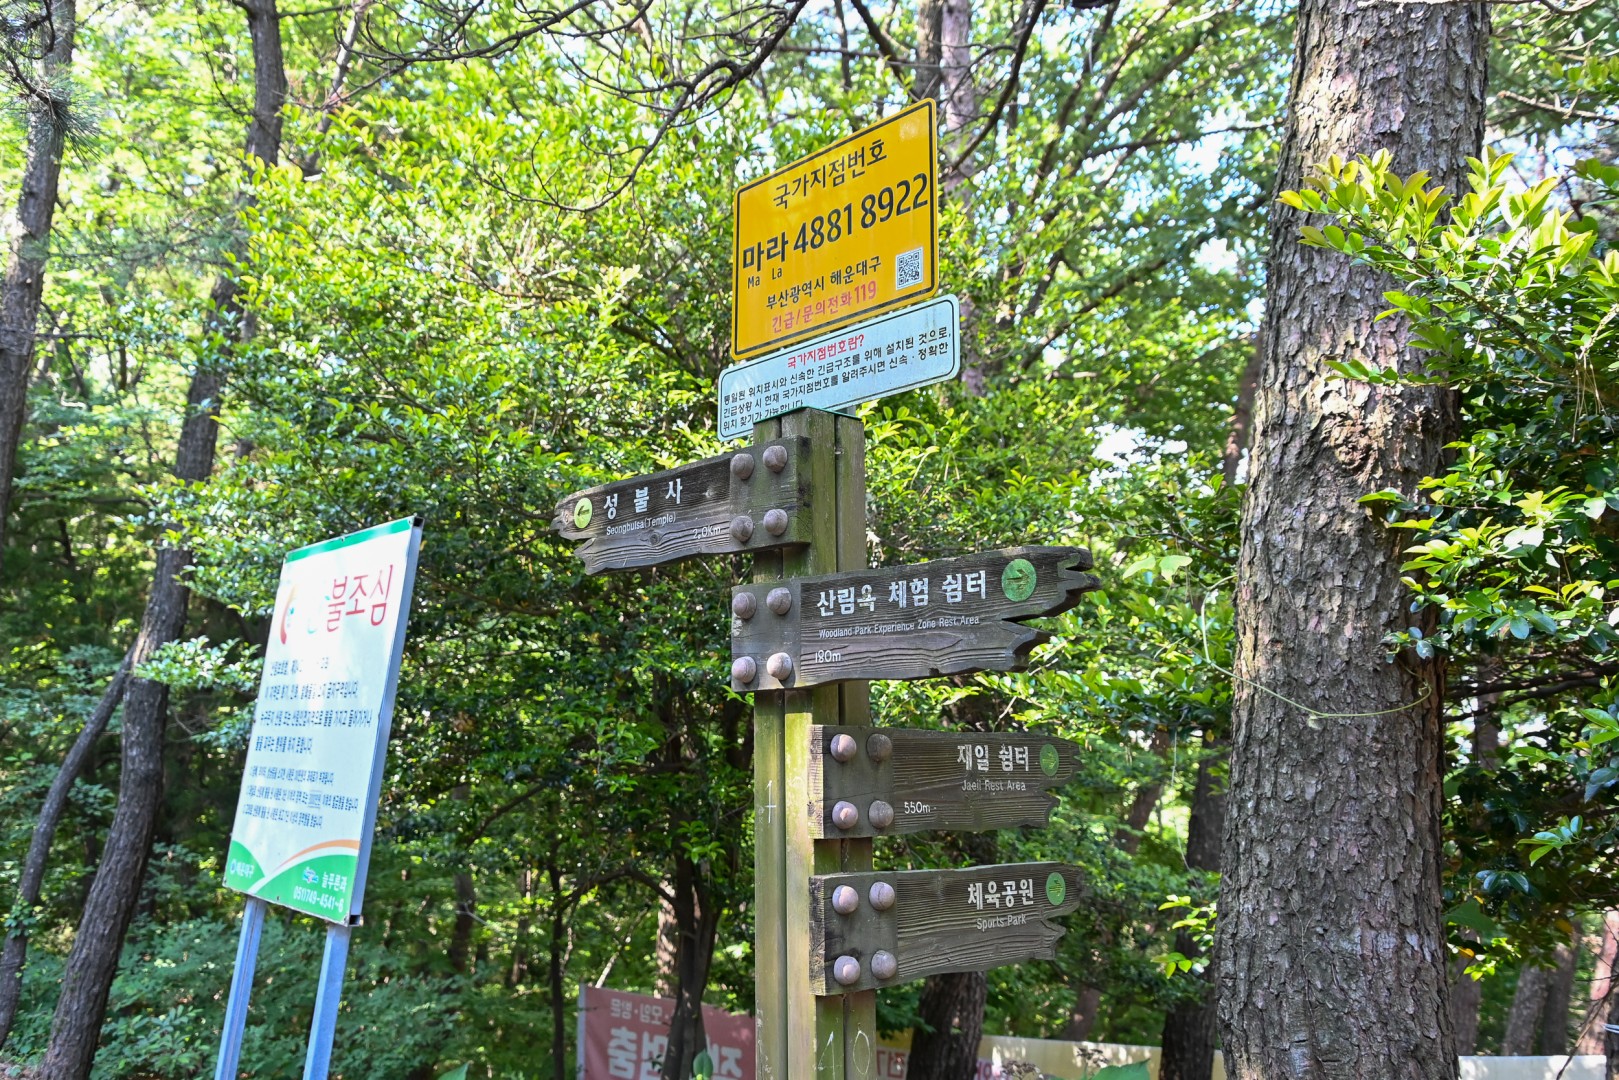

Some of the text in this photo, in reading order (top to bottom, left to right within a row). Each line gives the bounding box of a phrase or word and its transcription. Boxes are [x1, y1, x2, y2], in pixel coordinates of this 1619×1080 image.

[773, 139, 887, 209] 국가지점번호
[742, 173, 928, 272] 마라 4881 8922
[747, 267, 783, 289] Ma La
[766, 256, 881, 309] 부산광역시 해운대구
[772, 280, 877, 334] 긴급/문의전화 119
[787, 334, 865, 369] 국가지점번호란?
[723, 401, 752, 419] 긴급상황
[755, 398, 762, 409] 시
[764, 392, 780, 406] 현재
[782, 374, 838, 400] 국가지점번호를
[842, 361, 885, 383] 알려주시면
[889, 354, 908, 369] 신속
[918, 342, 948, 361] 정확한
[724, 389, 746, 406] 통일된
[748, 376, 787, 397] 위치표시와
[790, 368, 815, 385] 신속한
[818, 353, 860, 376] 긴급구조를
[864, 347, 882, 361] 위해
[886, 336, 914, 356] 설치된
[723, 419, 738, 432] 위치
[740, 412, 762, 427] 찾기가
[816, 570, 987, 617] 산림욕 체험 쉼터
[819, 615, 980, 639] Woodland Park Experience Zone Rest Area
[814, 649, 841, 664] 180m
[957, 743, 1029, 772] 재일 쉼터
[984, 780, 1003, 791] Rest
[1007, 780, 1026, 791] Area
[904, 801, 931, 814] 550m
[967, 879, 1034, 910] 체육공원
[976, 914, 1026, 932] Sports Park
